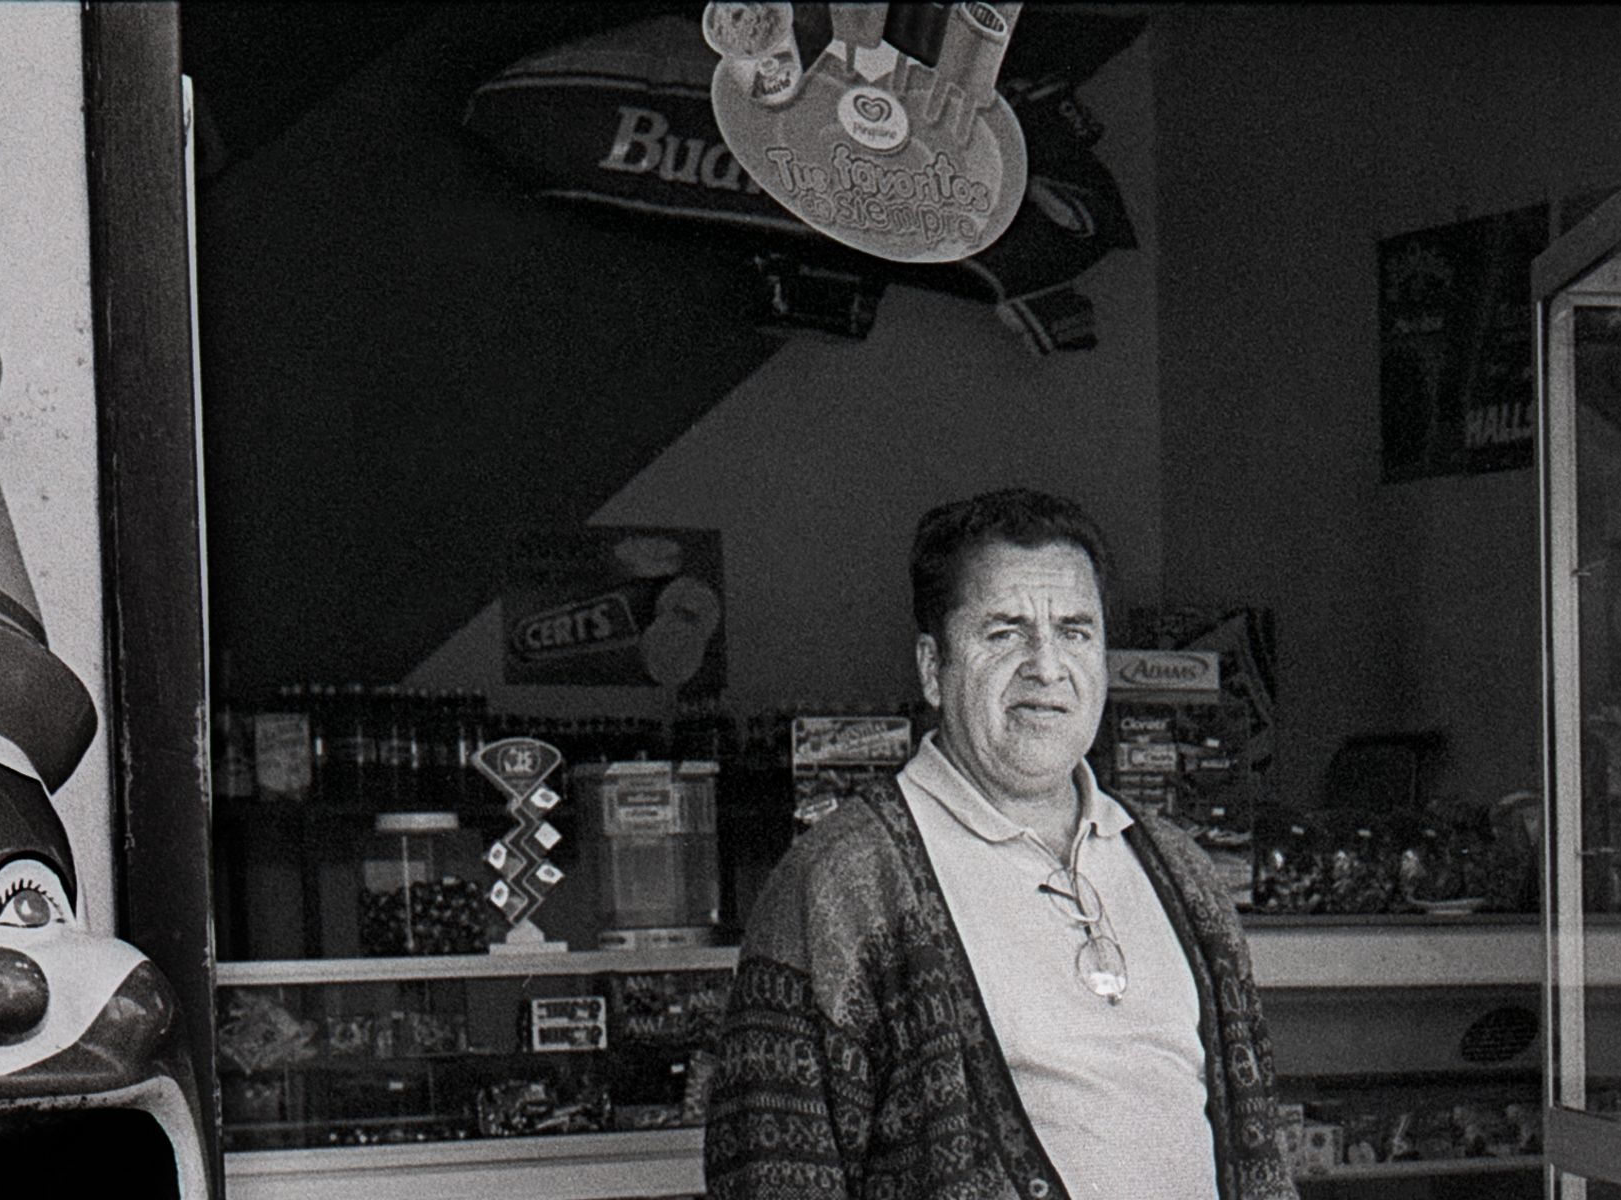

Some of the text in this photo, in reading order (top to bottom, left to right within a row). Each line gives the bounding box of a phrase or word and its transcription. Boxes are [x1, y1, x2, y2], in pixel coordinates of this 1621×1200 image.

[597, 106, 762, 196] Bud
[831, 142, 992, 213] favoritos
[525, 602, 614, 650] CERTS
